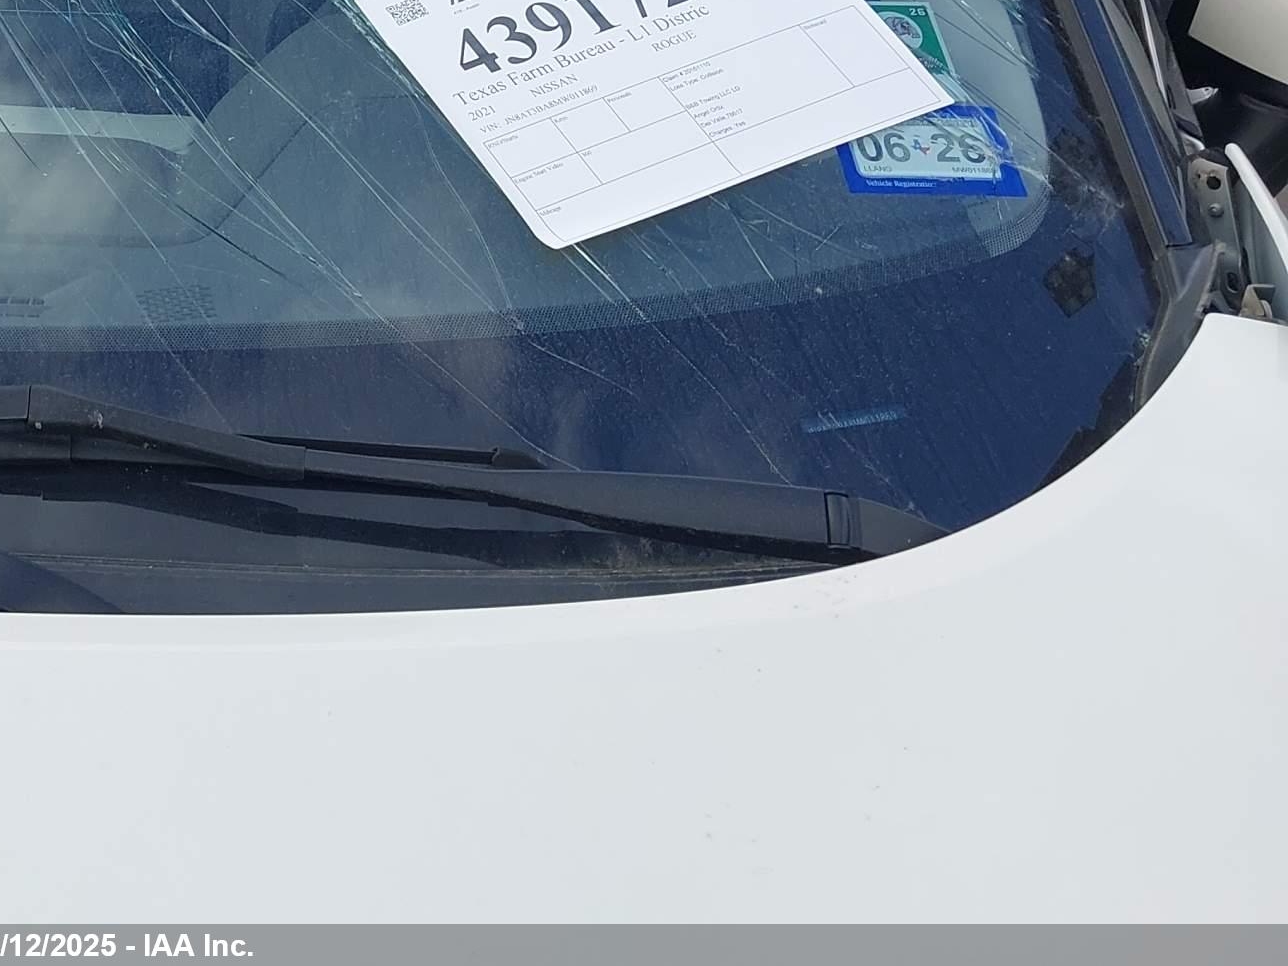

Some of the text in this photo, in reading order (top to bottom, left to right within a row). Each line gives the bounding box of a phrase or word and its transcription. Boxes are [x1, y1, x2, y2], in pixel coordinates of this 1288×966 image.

[909, 8, 926, 16] 26
[451, 80, 507, 105] Texas
[506, 63, 554, 85] Farm
[552, 40, 616, 68] Bureau
[651, 3, 709, 34] Distric
[467, 29, 696, 122] 2021 NISSAN ROGUE
[479, 122, 502, 133] VIN:
[857, 132, 911, 163] 06
[865, 179, 893, 188] Vehicle
